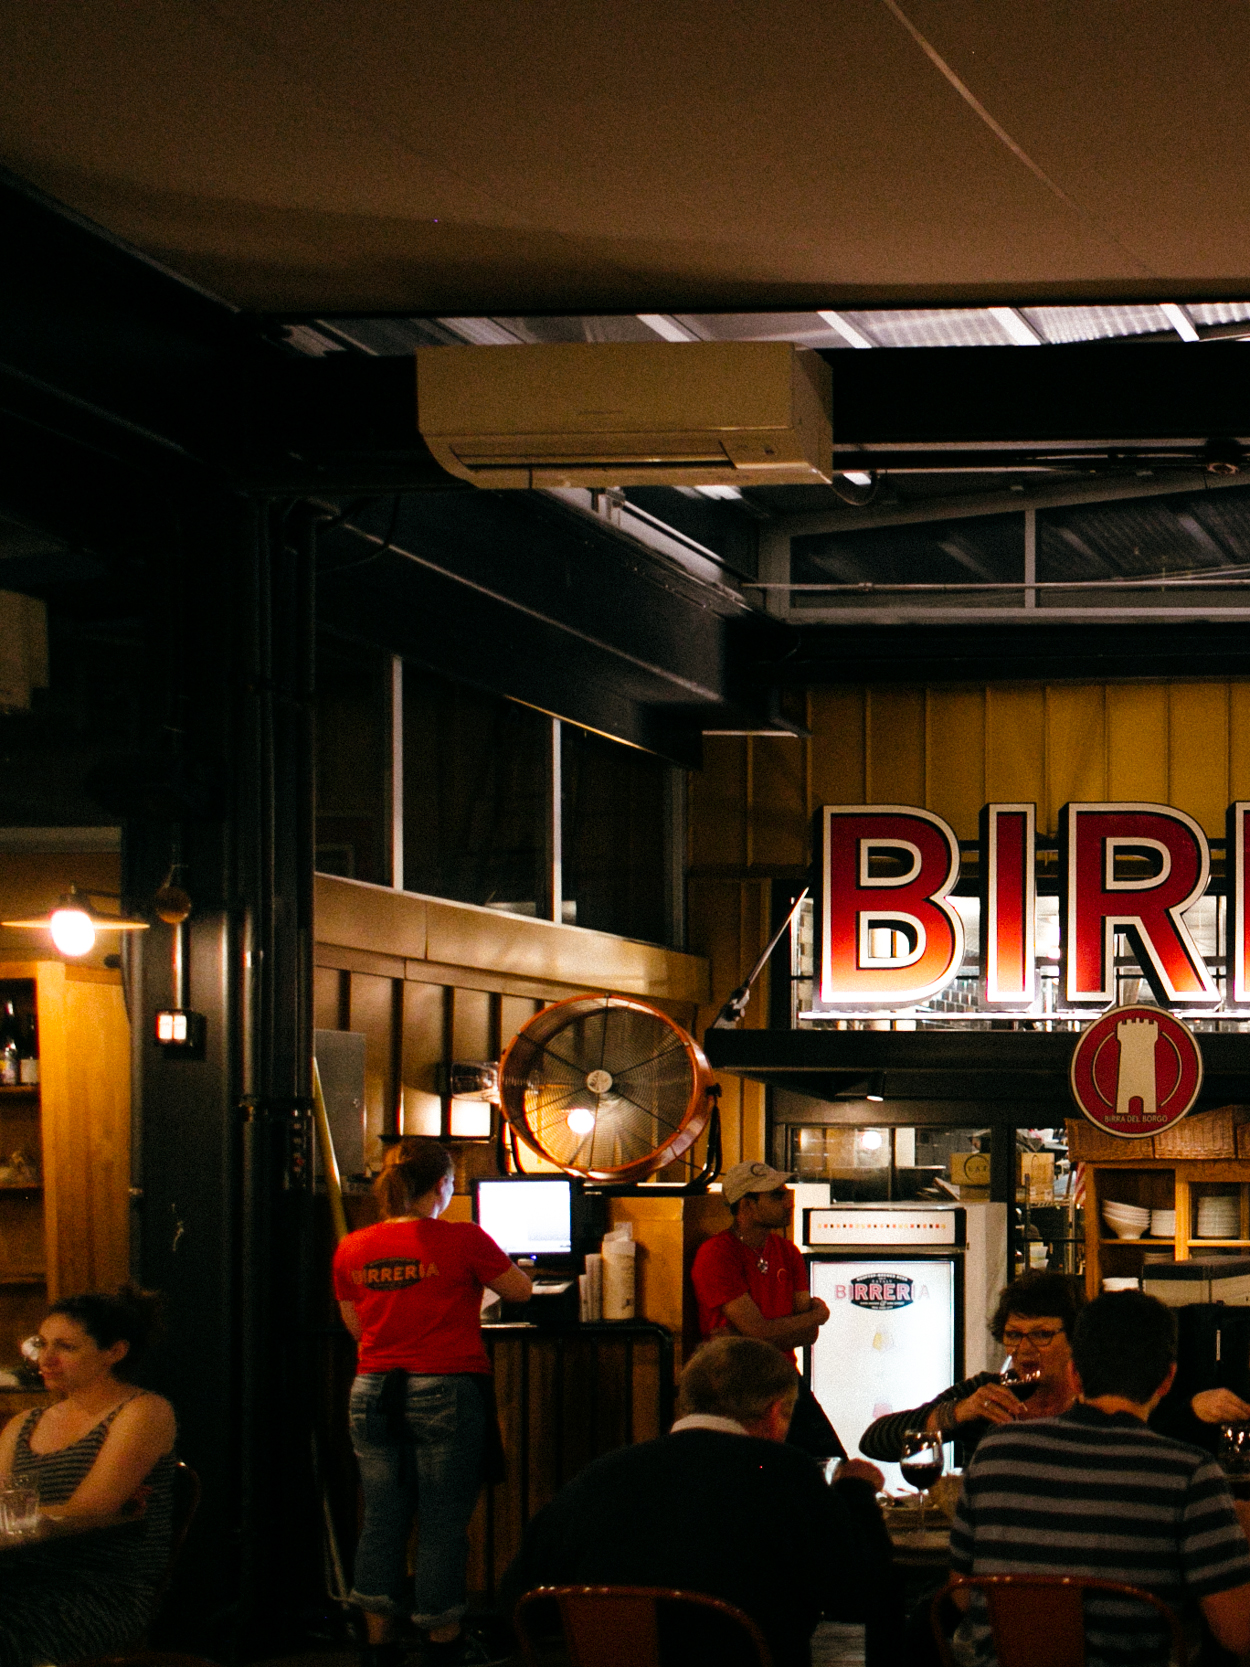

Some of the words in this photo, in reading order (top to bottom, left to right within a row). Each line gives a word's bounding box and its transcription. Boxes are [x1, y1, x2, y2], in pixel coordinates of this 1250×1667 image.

[1104, 1114, 1126, 1123] BIRRA
[1127, 1114, 1139, 1123] DEL
[1142, 1114, 1168, 1123] BORGO
[834, 1283, 931, 1301] BIRRERIA
